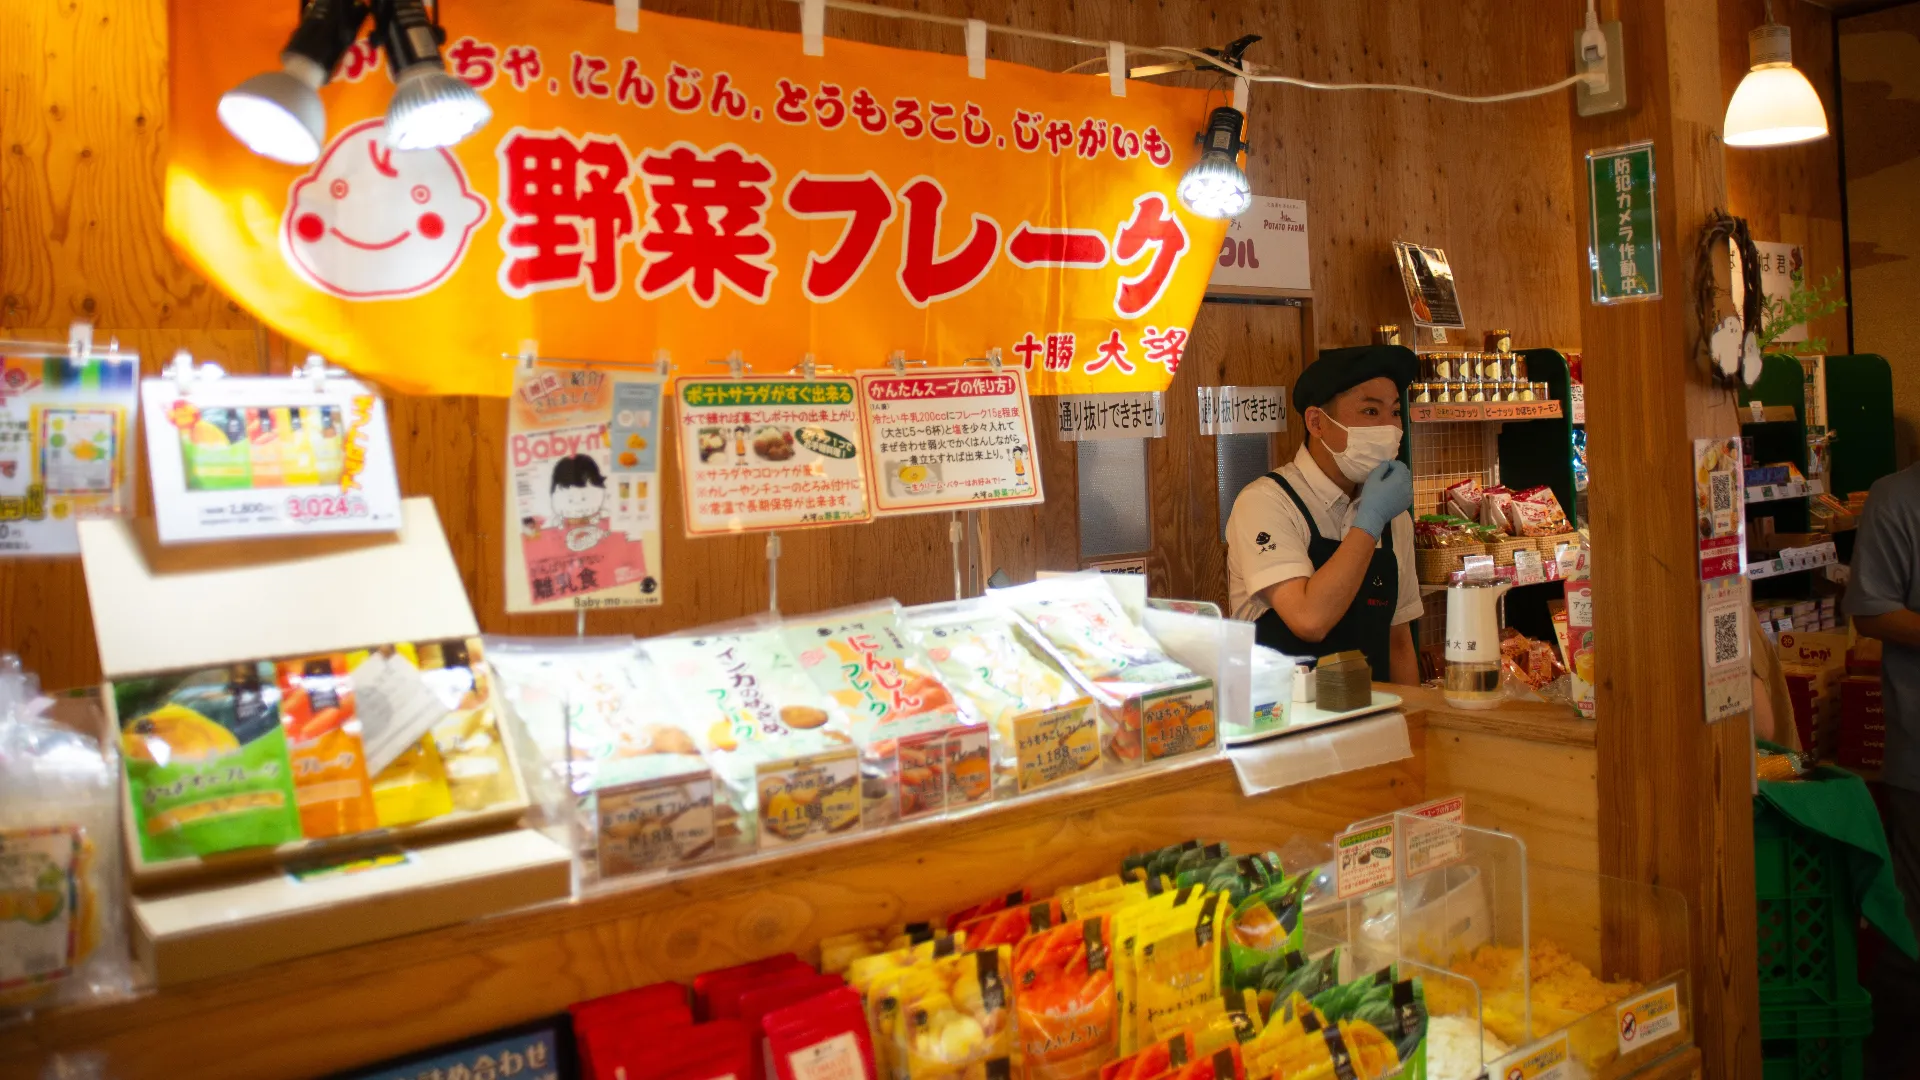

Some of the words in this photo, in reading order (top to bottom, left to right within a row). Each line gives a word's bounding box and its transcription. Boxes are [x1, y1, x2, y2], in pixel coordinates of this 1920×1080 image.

[498, 130, 1190, 318] 野菜フレーク
[1263, 219, 1286, 231] POTATO
[1287, 223, 1305, 232] FARM
[1613, 157, 1640, 294] 防犯カメラ作動中
[1012, 331, 1075, 373] 十勝
[686, 384, 852, 404] ポテトサラダがすぐ出来る
[1059, 398, 1165, 432] 通り抜けできません
[1200, 393, 1286, 425] 通り抜けできません
[511, 425, 602, 468] Baby-m
[880, 434, 1020, 453] まぜ合わせ弱火でかくはんしながら
[840, 662, 888, 716] フレーク
[845, 632, 922, 711] にんじん
